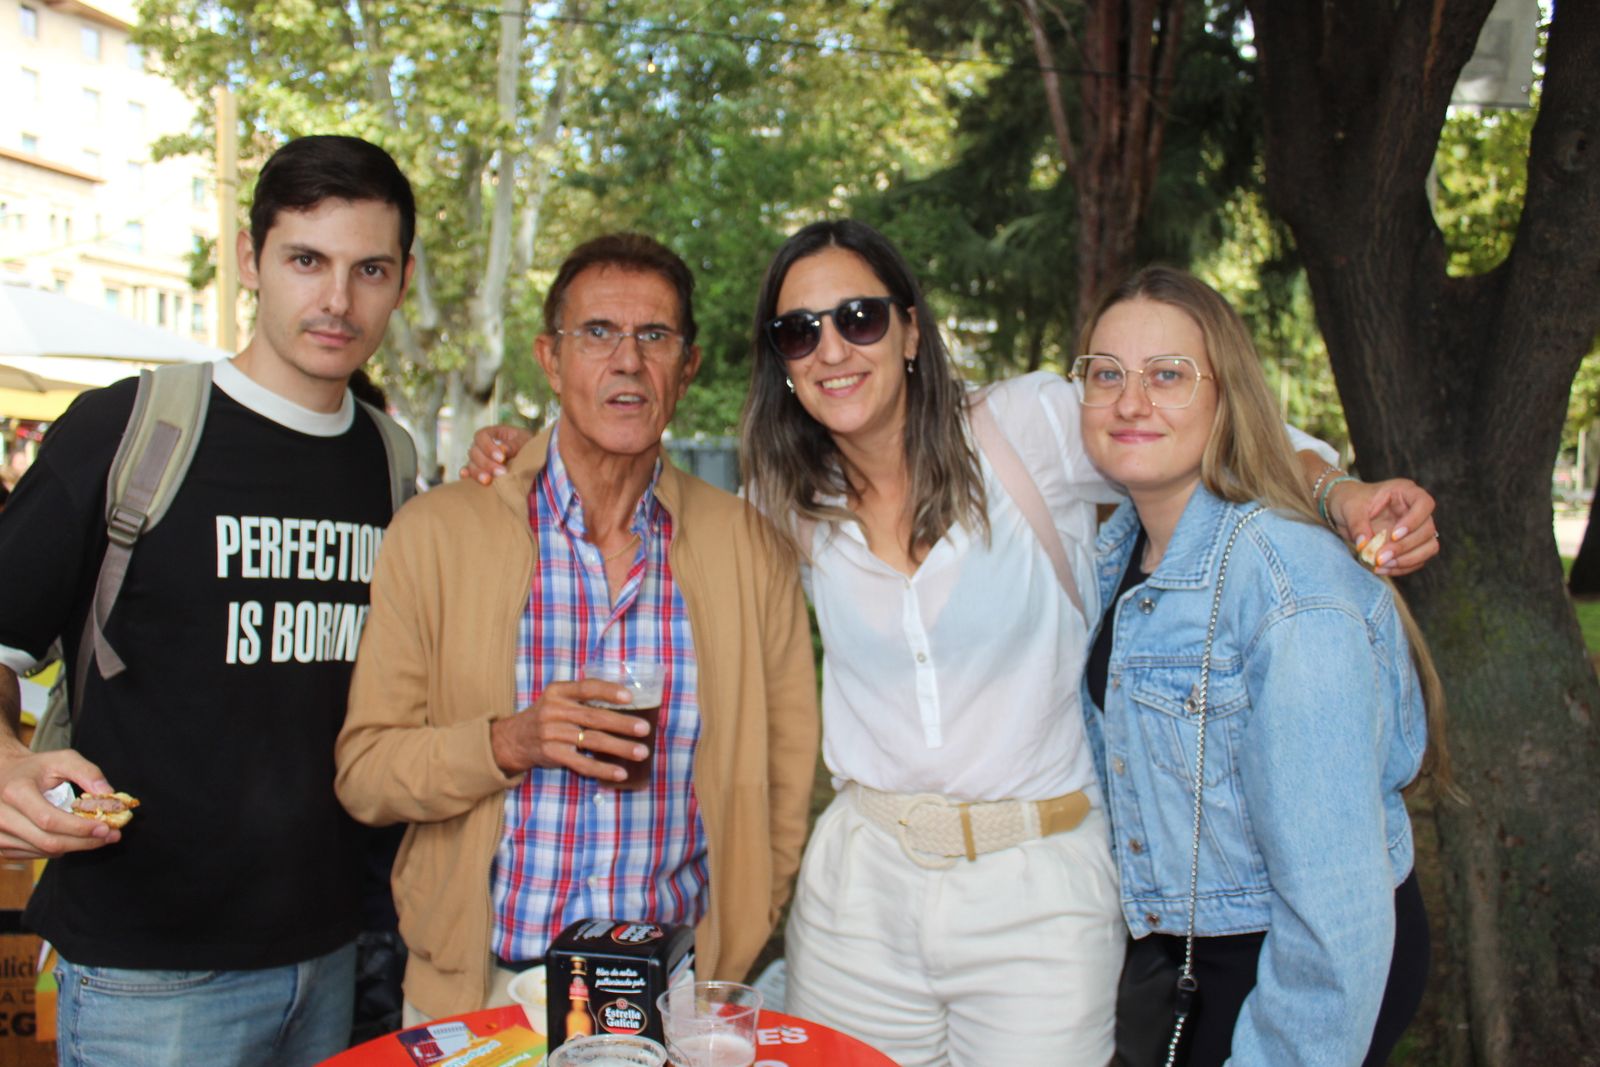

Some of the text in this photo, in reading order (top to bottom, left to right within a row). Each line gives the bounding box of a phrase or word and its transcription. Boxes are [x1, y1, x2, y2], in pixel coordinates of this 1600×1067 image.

[226, 600, 370, 665] IS BORIN
[605, 1006, 641, 1020] Estrella
[606, 1017, 640, 1029] Galicia
